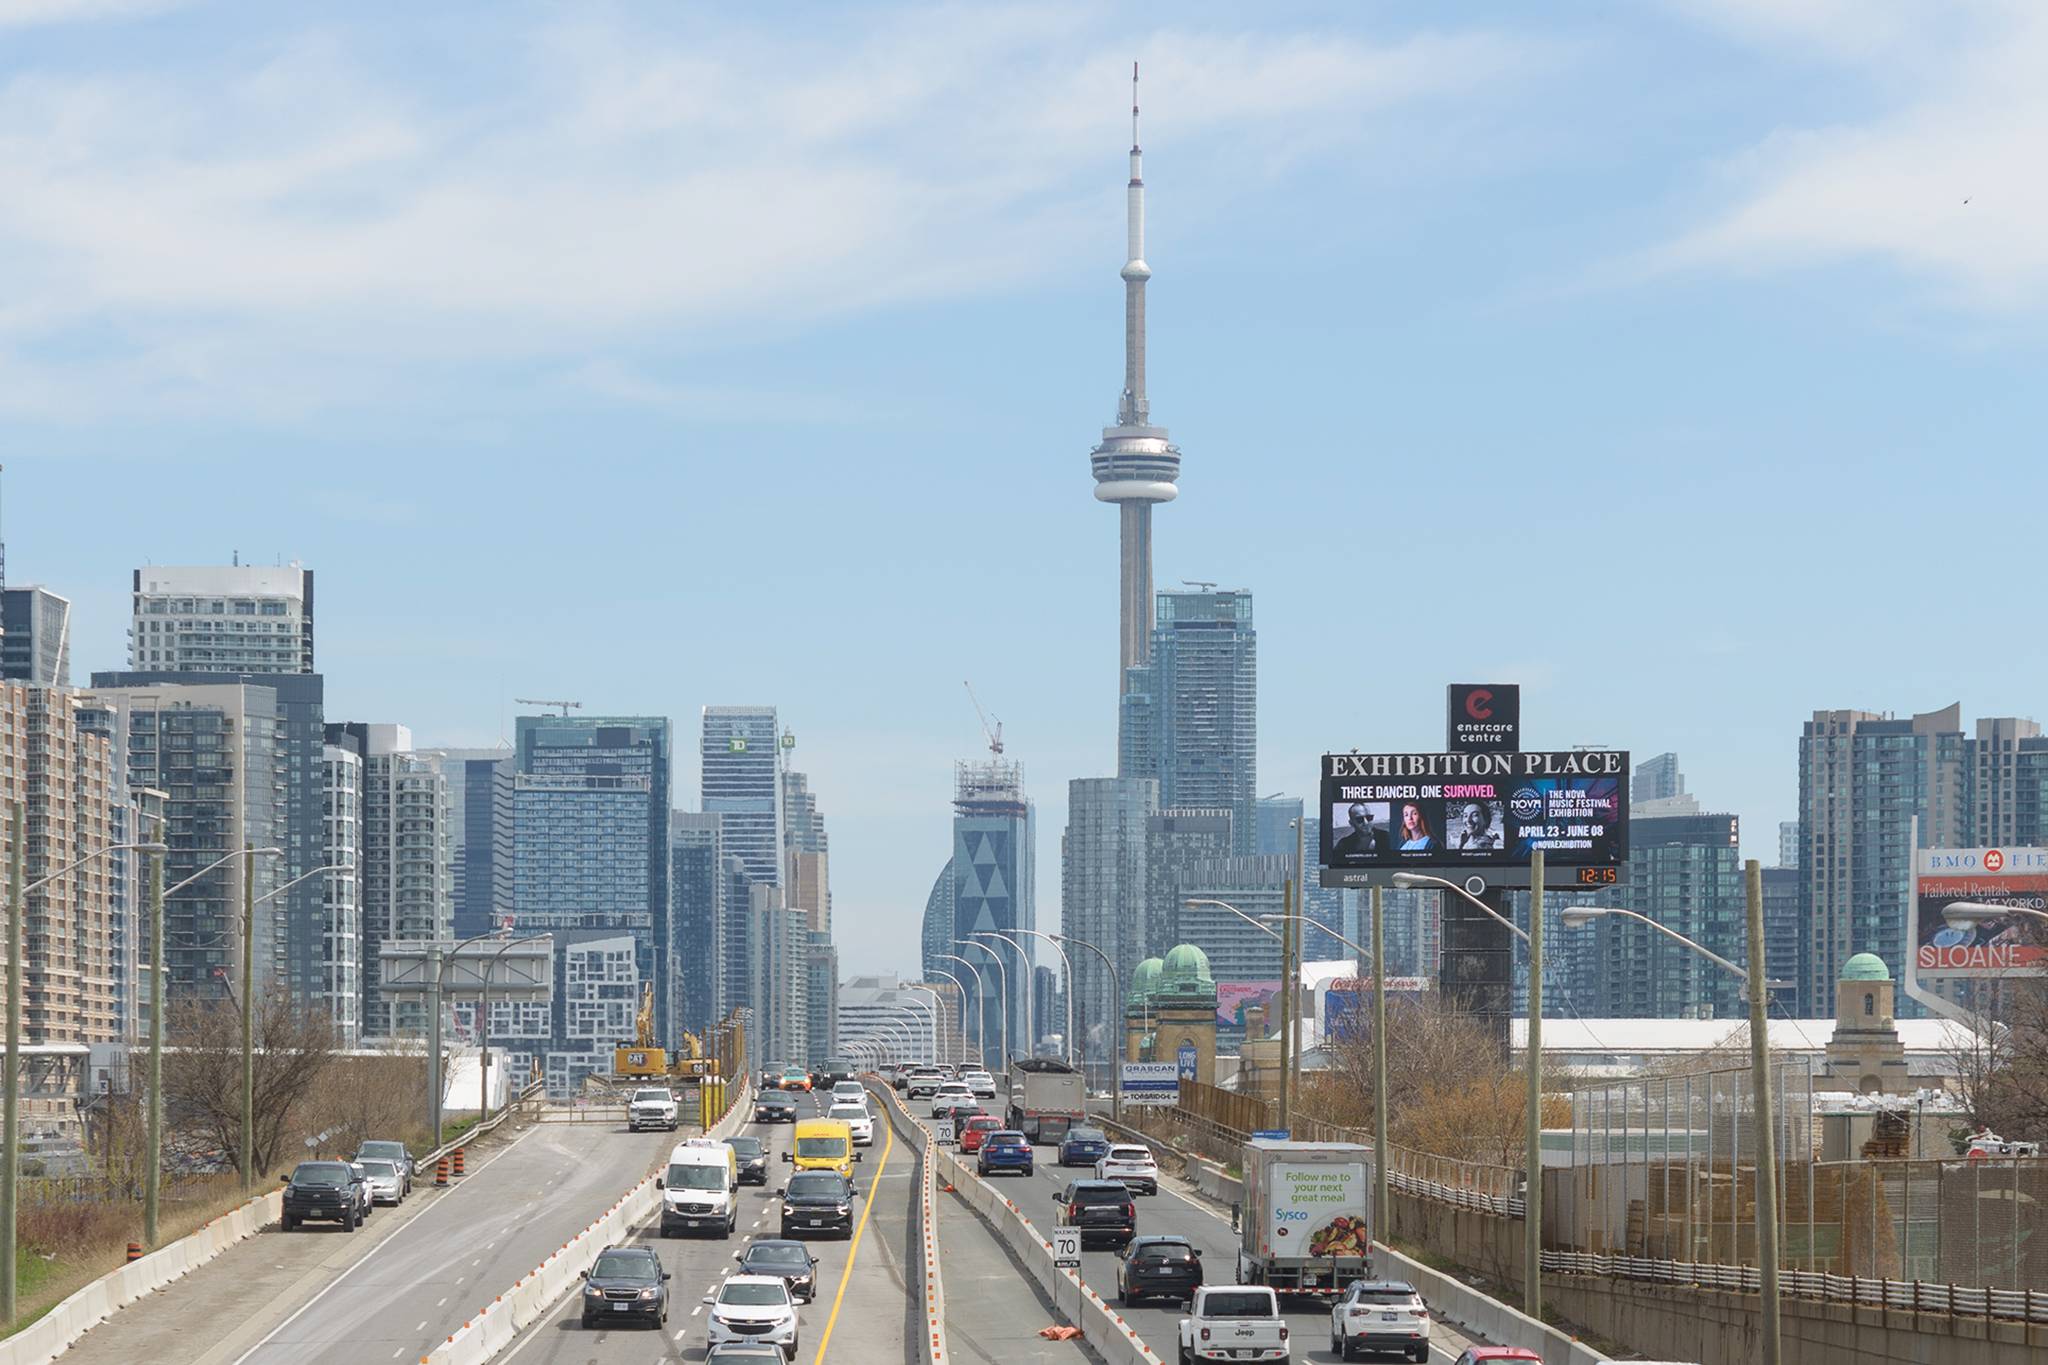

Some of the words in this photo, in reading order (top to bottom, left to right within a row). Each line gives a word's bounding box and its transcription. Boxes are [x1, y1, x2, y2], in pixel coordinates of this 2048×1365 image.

[1457, 723, 1513, 732] enercare
[1460, 733, 1502, 742] centre
[731, 740, 744, 750] TD
[1330, 754, 1512, 777] EXHIBITION
[1524, 752, 1621, 775] PLACE
[1341, 786, 1374, 799] THREE
[1376, 785, 1420, 800] DANCED,
[1421, 785, 1442, 798] ONE
[1443, 784, 1497, 798] SURVIVED.
[1548, 790, 1564, 799] THE
[1565, 789, 1587, 799] NOVA
[1548, 799, 1574, 809] MUSIC
[1576, 798, 1612, 808] FESTIVAL
[1548, 808, 1594, 818] EXHIBITION
[1518, 826, 1546, 838] APRIL
[1547, 825, 1560, 837] 23
[1566, 825, 1589, 837] JUNE
[1590, 825, 1604, 837] 08
[1531, 840, 1593, 850] @NOVAEXHIBITION
[1931, 855, 1977, 868] BMO
[1343, 873, 1369, 882] astral
[1581, 868, 1616, 882] 12:15
[1922, 882, 1968, 898] Tailored
[1971, 881, 2011, 897] Rentals
[1919, 944, 2022, 968] SLOANE
[628, 1052, 645, 1065] CAT
[1180, 1059, 1195, 1067] LIVE
[939, 1127, 951, 1137] 70
[1285, 1172, 1319, 1182] Follow
[1321, 1174, 1338, 1182] me
[1340, 1173, 1351, 1182] to
[1294, 1184, 1317, 1193] your
[1320, 1183, 1343, 1192] next
[1291, 1194, 1319, 1204] great
[1321, 1193, 1346, 1202] meal
[1275, 1208, 1308, 1222] Sysco
[1057, 1239, 1076, 1254] 70
[1234, 1329, 1255, 1337] Jeep
